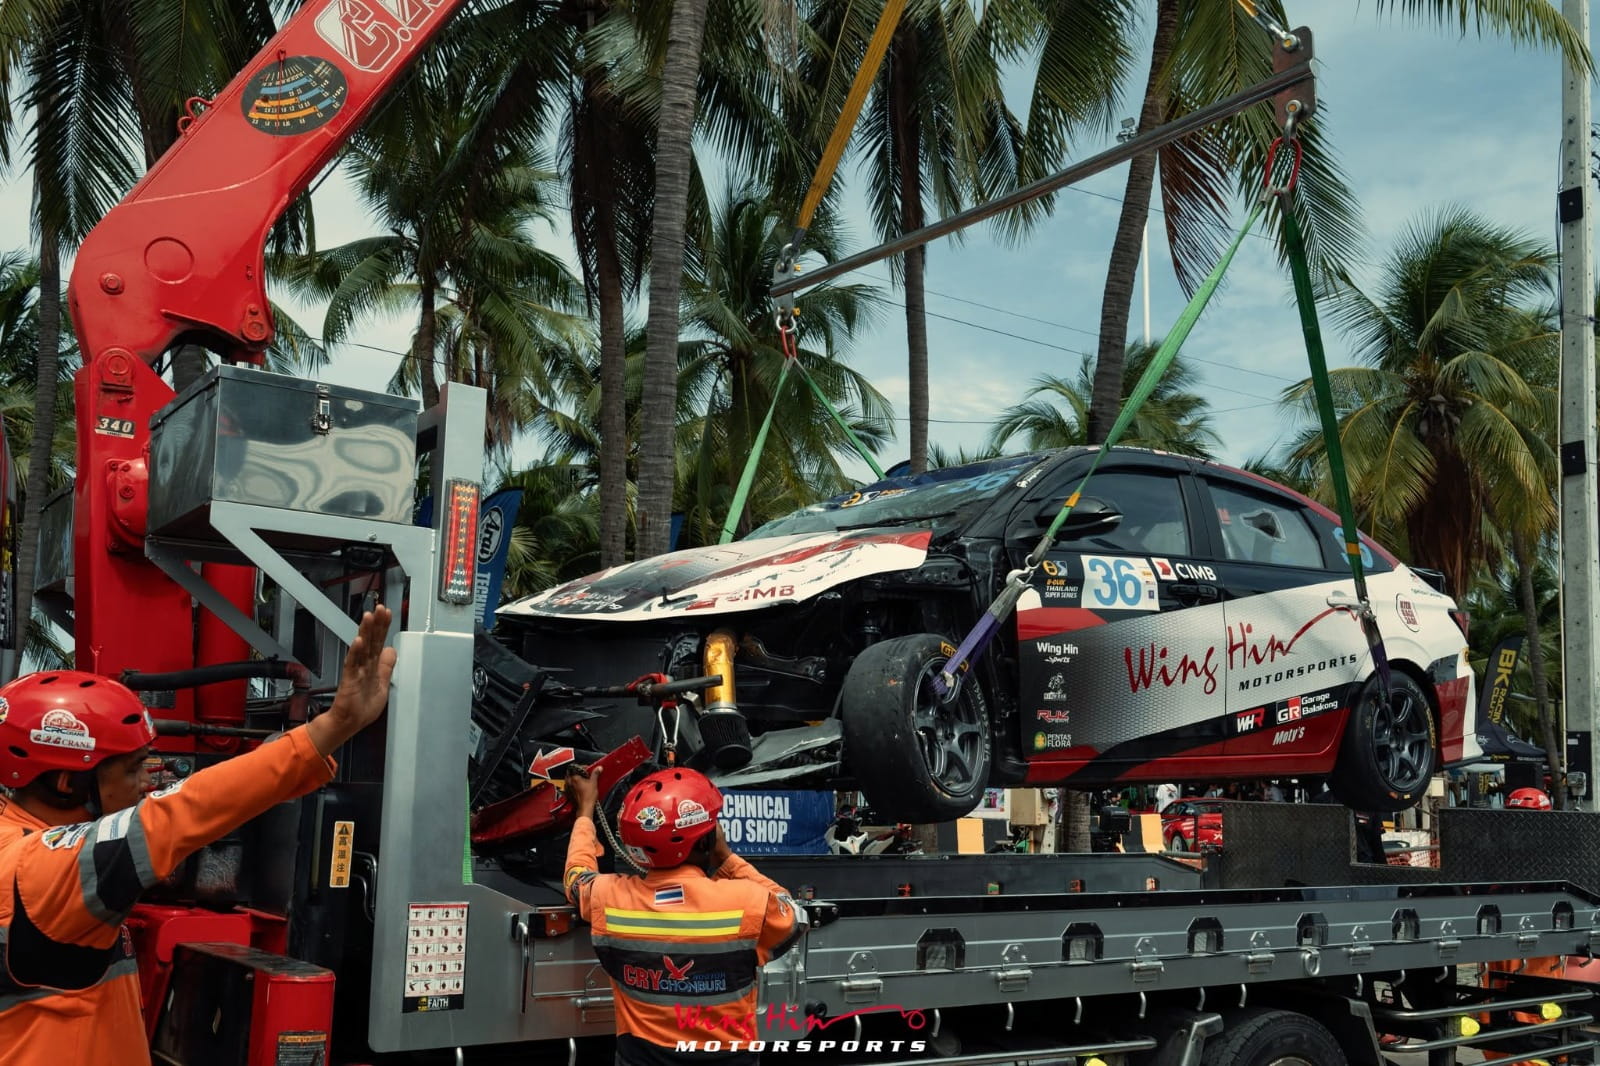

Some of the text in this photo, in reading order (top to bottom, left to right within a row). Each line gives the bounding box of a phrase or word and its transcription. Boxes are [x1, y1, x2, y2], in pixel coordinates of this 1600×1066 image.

[99, 417, 133, 433] 340
[480, 510, 500, 557] Arai
[1175, 562, 1217, 581] CIMB
[1088, 558, 1142, 606] 36
[1044, 591, 1060, 599] SUPER
[1036, 642, 1079, 655] Wing Hin
[1124, 642, 1219, 695] Wing
[1238, 653, 1358, 692] MOTORSPORTS
[1494, 649, 1517, 688] BK
[1301, 692, 1331, 705] Garage
[1302, 700, 1339, 715] Balakong
[1277, 705, 1301, 722] GR
[1047, 740, 1071, 748] FLORA
[1272, 726, 1305, 746] Moty's
[717, 794, 792, 819] CHNICAL
[745, 819, 788, 843] SHOP
[623, 964, 663, 991] CRY
[660, 979, 726, 993] CHONBURI
[428, 998, 449, 1009] FAITH
